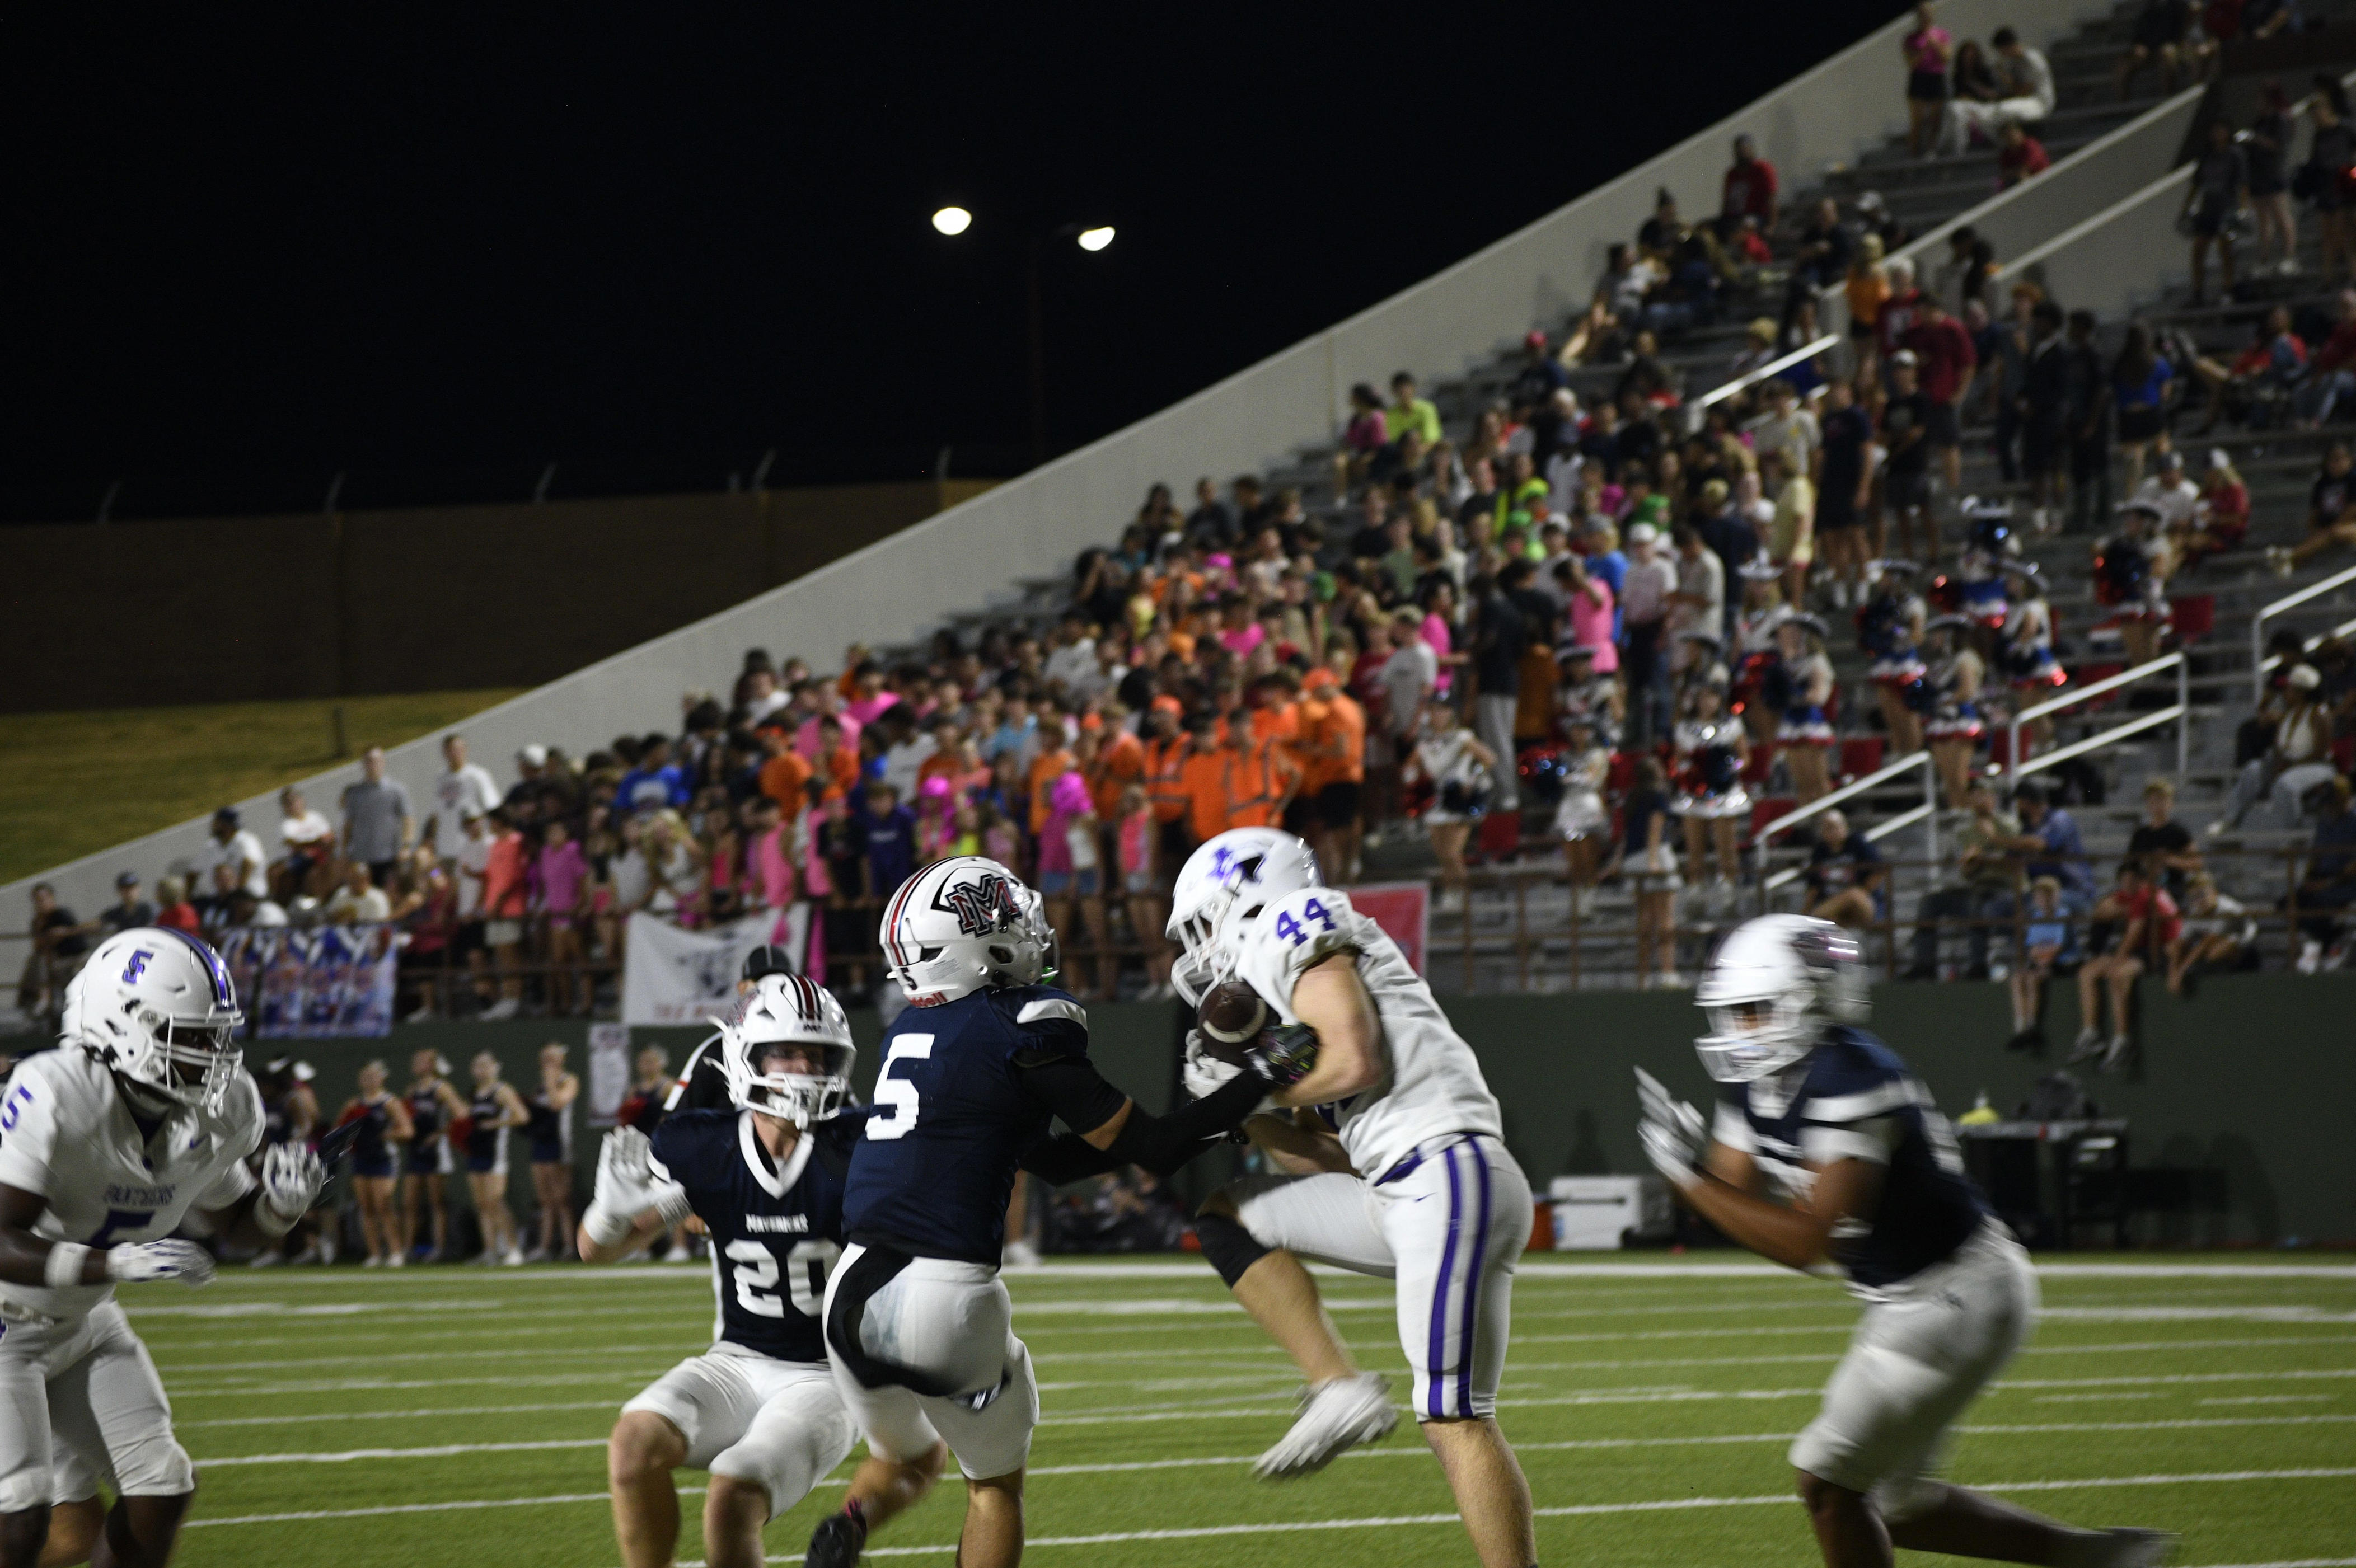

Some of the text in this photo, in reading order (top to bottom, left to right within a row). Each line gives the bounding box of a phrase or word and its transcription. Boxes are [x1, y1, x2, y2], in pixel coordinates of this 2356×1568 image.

[1277, 898, 1337, 946] 44
[121, 949, 154, 984] 5
[900, 967, 918, 990] 5
[2, 1083, 35, 1130] 5
[865, 1032, 935, 1141] 5
[724, 1237, 842, 1319] 20
